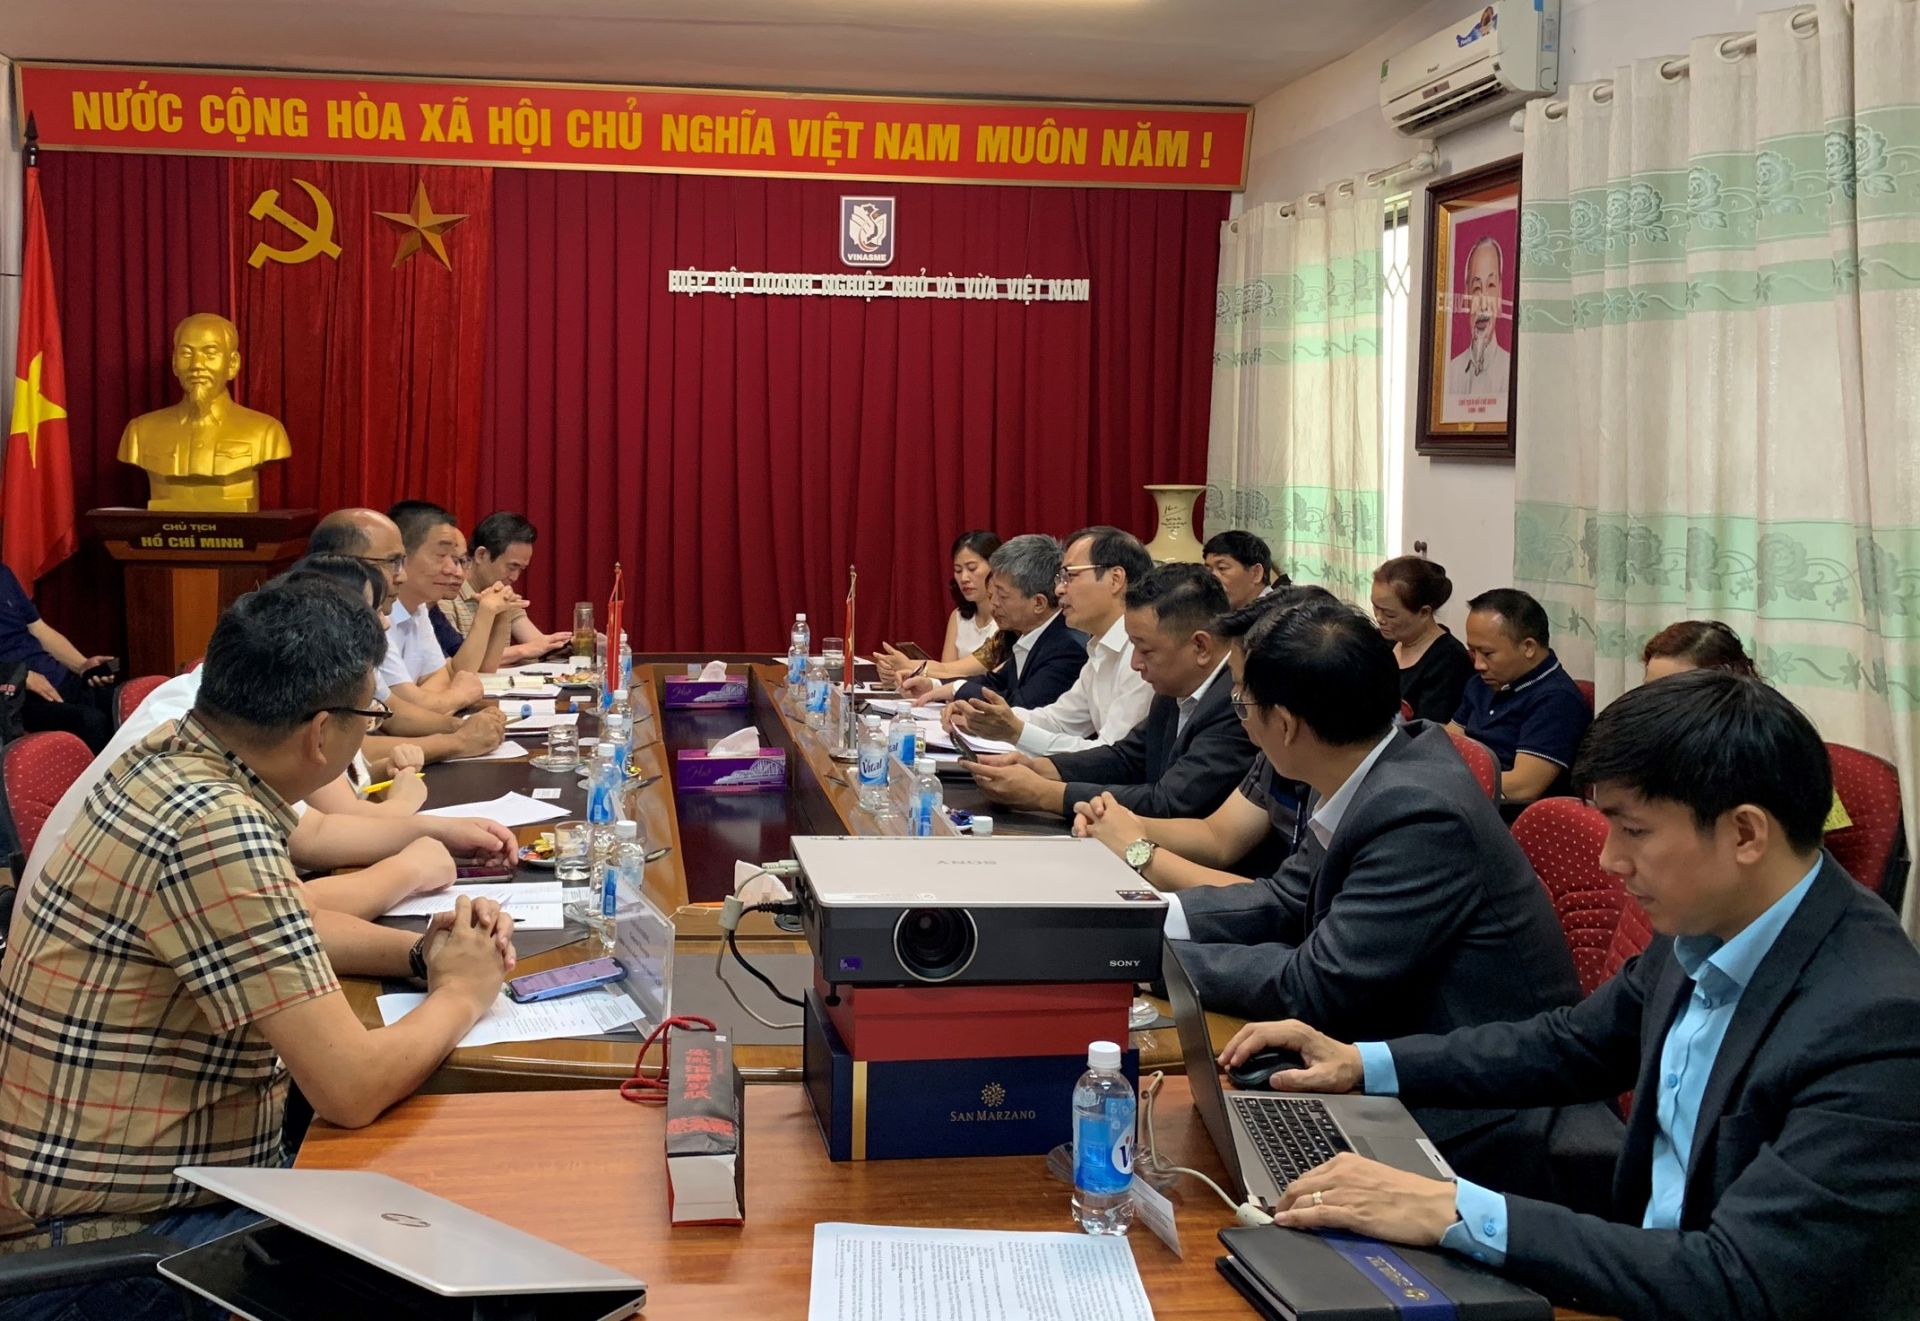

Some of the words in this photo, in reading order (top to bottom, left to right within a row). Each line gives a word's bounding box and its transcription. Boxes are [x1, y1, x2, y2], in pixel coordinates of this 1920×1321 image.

[73, 82, 182, 132] NƯỚC
[200, 88, 308, 143] CỘNG
[328, 92, 405, 141] HÒA
[421, 96, 473, 144] XÃ
[489, 98, 551, 154] HỘI
[567, 97, 642, 151] CHỦ
[661, 109, 775, 156] NGHĨA
[788, 112, 864, 167] VIỆT
[873, 121, 960, 162] NAM
[976, 119, 1087, 165] MUÔN
[1101, 122, 1188, 167] NĂM
[847, 253, 888, 262] VINASME
[668, 267, 708, 297] HIỆP
[715, 267, 744, 299] HỘI
[752, 272, 813, 295] DOANH
[821, 270, 886, 302] NGHIỆP
[892, 267, 928, 298] NHỎ
[936, 271, 958, 299] VÀ
[963, 272, 999, 300] VỪA
[1006, 273, 1043, 305] VIỆT
[1048, 278, 1090, 301] NAM
[162, 520, 187, 531] CHỦ
[189, 523, 217, 533] TỊCH
[141, 532, 163, 547] HỒ
[168, 534, 196, 548] CHÍ
[200, 537, 244, 549] MINH
[862, 758, 883, 774] Vital
[1109, 959, 1141, 967] SONY
[976, 1110, 1037, 1121] MARZANO
